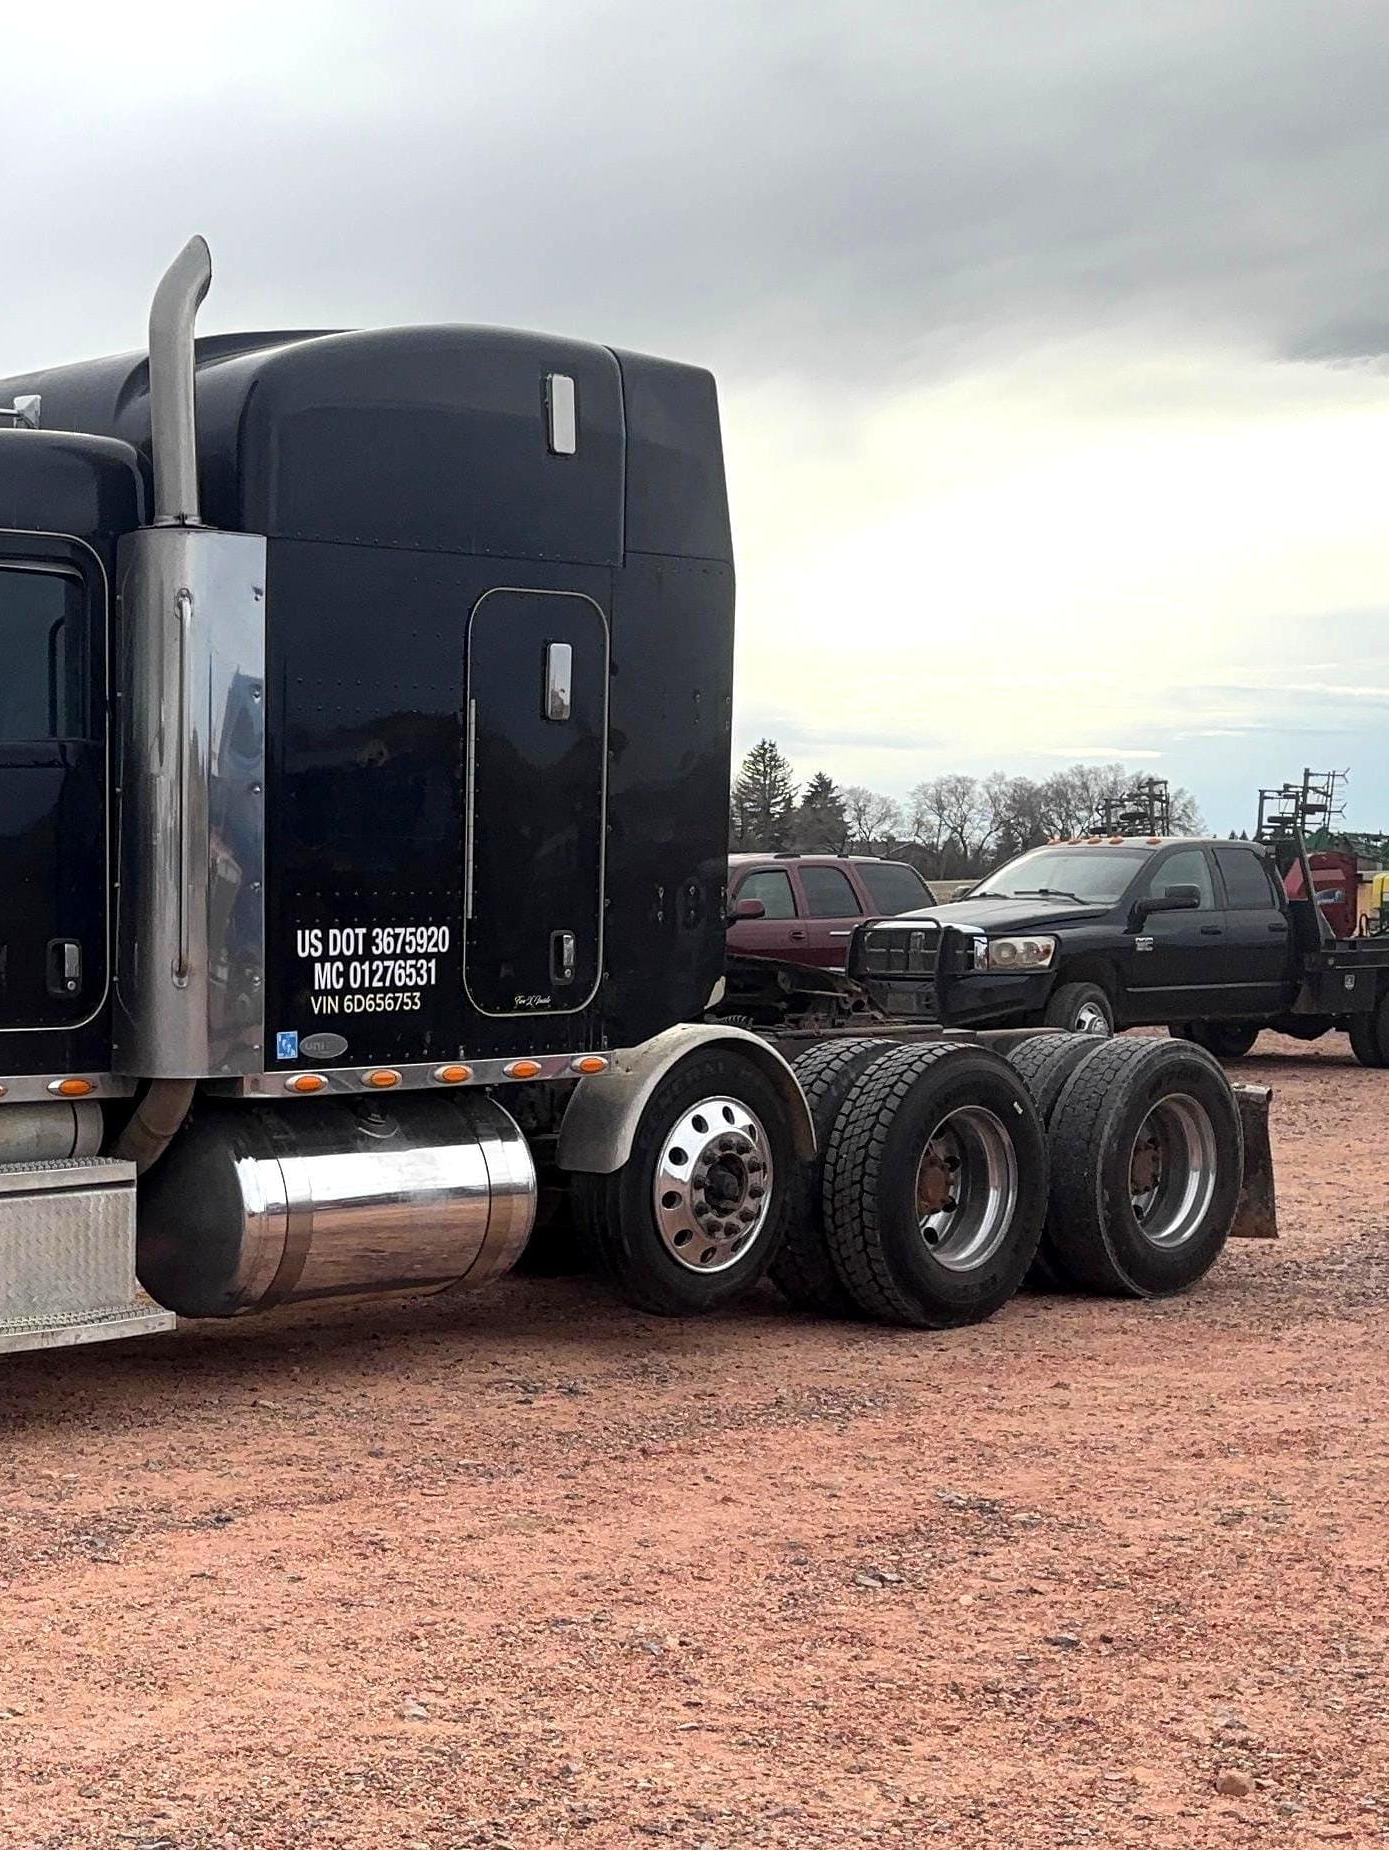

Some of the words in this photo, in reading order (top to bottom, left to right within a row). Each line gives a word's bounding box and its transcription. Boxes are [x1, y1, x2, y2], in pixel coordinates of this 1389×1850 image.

[296, 928, 323, 958] US
[328, 927, 367, 957] DOT
[371, 925, 450, 955] 3675920
[314, 960, 344, 990] MC
[349, 958, 437, 989] 01276531
[310, 995, 339, 1015] VIN
[343, 992, 421, 1013] 6D656753
